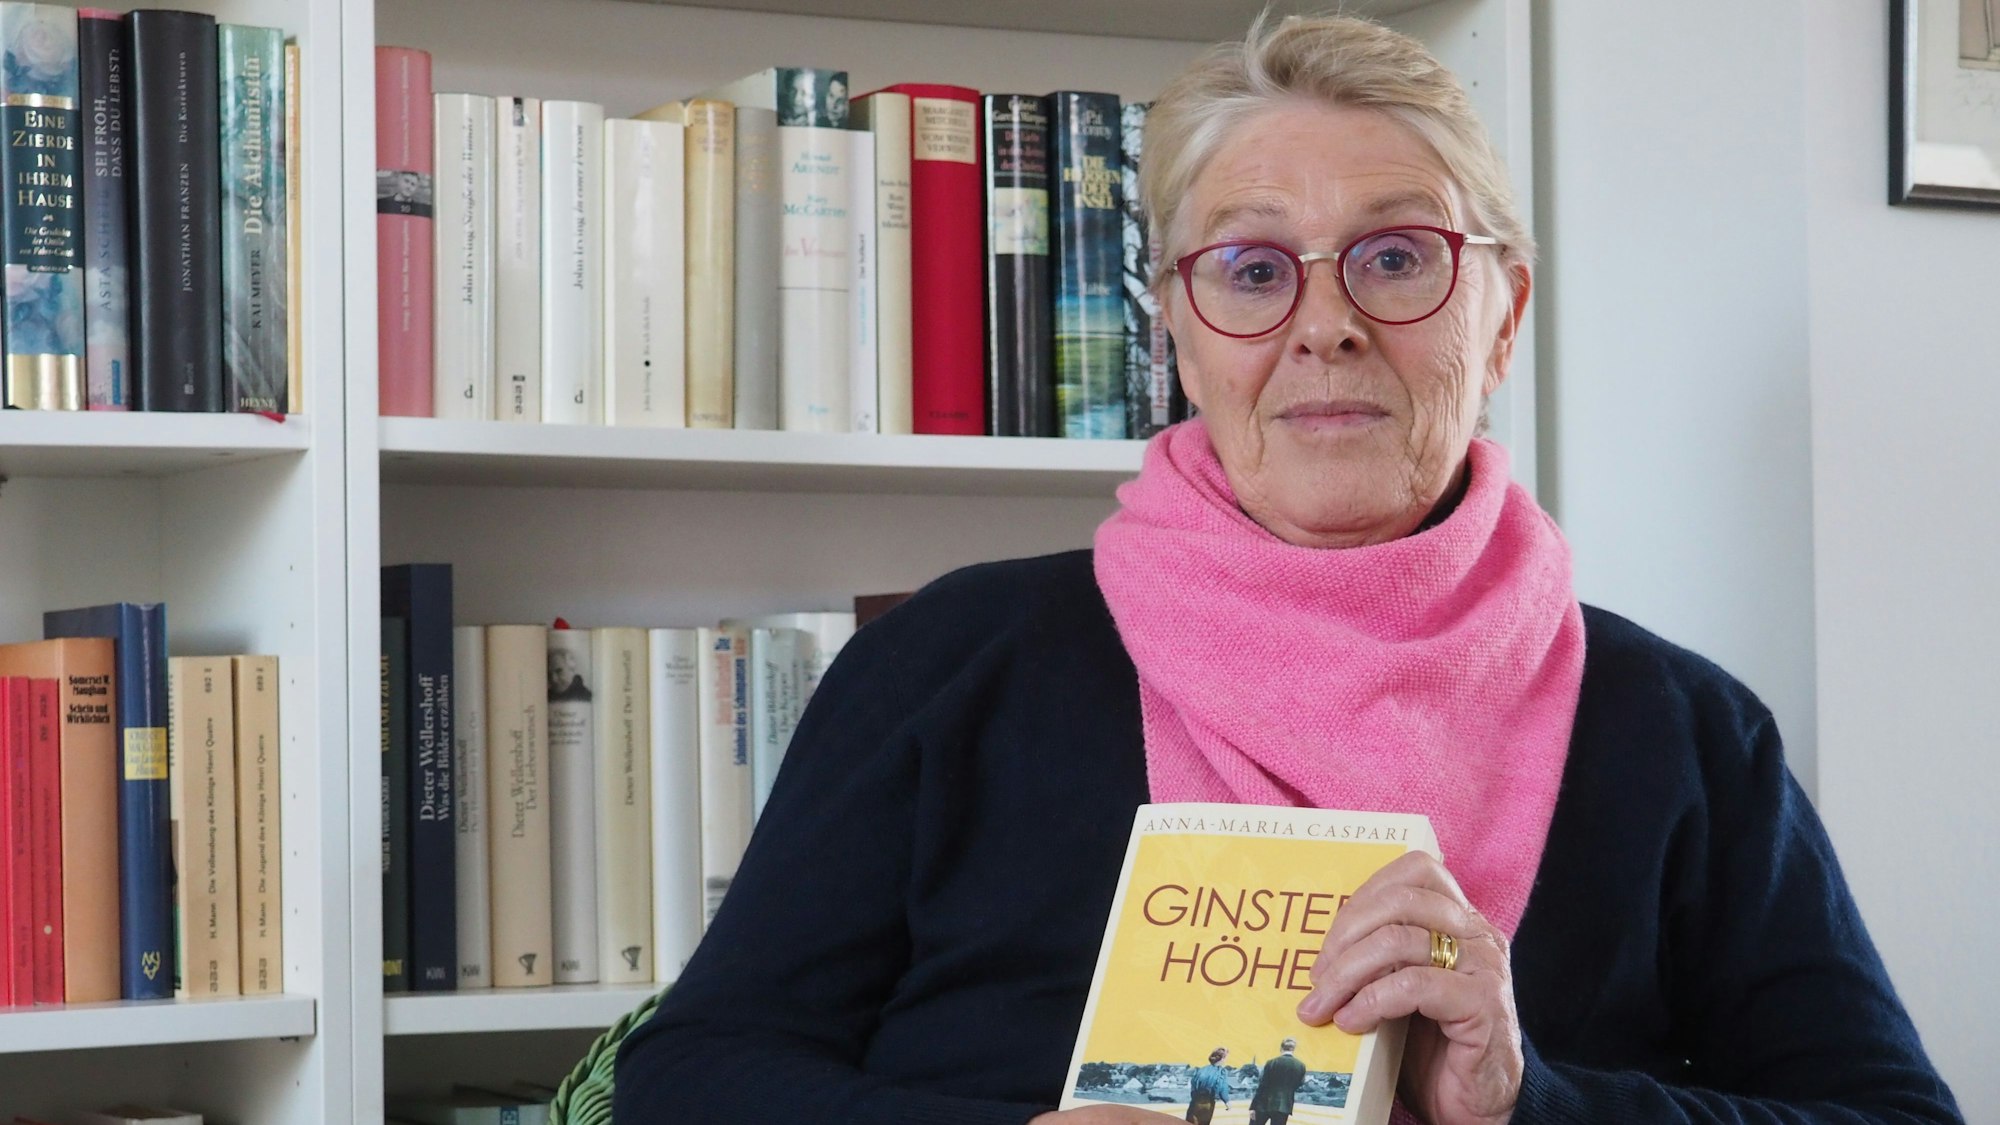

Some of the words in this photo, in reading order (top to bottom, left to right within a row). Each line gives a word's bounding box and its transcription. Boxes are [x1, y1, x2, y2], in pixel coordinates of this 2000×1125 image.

[177, 51, 188, 121] Korrekturen
[24, 110, 66, 130] EINE
[94, 95, 108, 146] FROH,
[109, 107, 122, 132] DU
[241, 56, 264, 187] Alchimistin
[1085, 109, 1104, 126] Pat
[12, 130, 75, 151] ZIERDE
[178, 123, 189, 143] Die
[36, 153, 57, 168] IN
[95, 149, 109, 178] SEI
[110, 136, 123, 178] DASS
[1082, 155, 1107, 170] DIE
[18, 171, 74, 189] IHREM
[179, 162, 191, 220] FRANZEN
[1082, 181, 1112, 196] DER
[18, 189, 75, 209] HAUSE
[243, 192, 264, 235] Die
[461, 229, 476, 271] Irving
[572, 216, 588, 257] Irving
[180, 223, 193, 292] JONATHAN
[98, 265, 113, 312] ASTA
[250, 249, 262, 298] MEYER
[462, 272, 475, 304] John
[572, 259, 586, 291] John
[251, 301, 263, 329] KAI
[240, 397, 277, 409] HEYNE
[1152, 371, 1165, 409] Josef
[68, 675, 103, 686] Somerset
[72, 685, 107, 697] Maugham
[69, 703, 94, 714] Schein
[95, 703, 108, 713] und
[436, 674, 449, 728] erzählen
[205, 717, 216, 748] Quatre
[418, 673, 434, 768] Wellershoff
[734, 711, 747, 726] des
[256, 734, 266, 765] Quatre
[437, 731, 449, 769] Bilder
[524, 704, 537, 786] Liebeswunsch
[206, 749, 214, 774] Henri
[457, 738, 469, 798] Wellershoff
[509, 728, 524, 798] Wellershoff
[205, 776, 216, 807] Königs
[256, 766, 266, 791] Henri
[437, 771, 449, 791] die
[624, 777, 635, 806] Dieter
[419, 771, 435, 821] Dieter
[437, 793, 450, 821] Was
[526, 789, 538, 811] Der
[206, 809, 215, 825] des
[458, 800, 469, 833] Dieter
[511, 800, 525, 839] Dieter
[1144, 817, 1295, 836] ANNA-MARIA
[1306, 822, 1409, 842] CASPARI
[258, 826, 266, 842] des
[207, 826, 217, 876] Vollendung
[258, 843, 268, 876] Jugend
[208, 879, 216, 895] Die
[258, 878, 266, 894] Die
[209, 902, 217, 928] Mann
[1160, 934, 1321, 991] HÖHE
